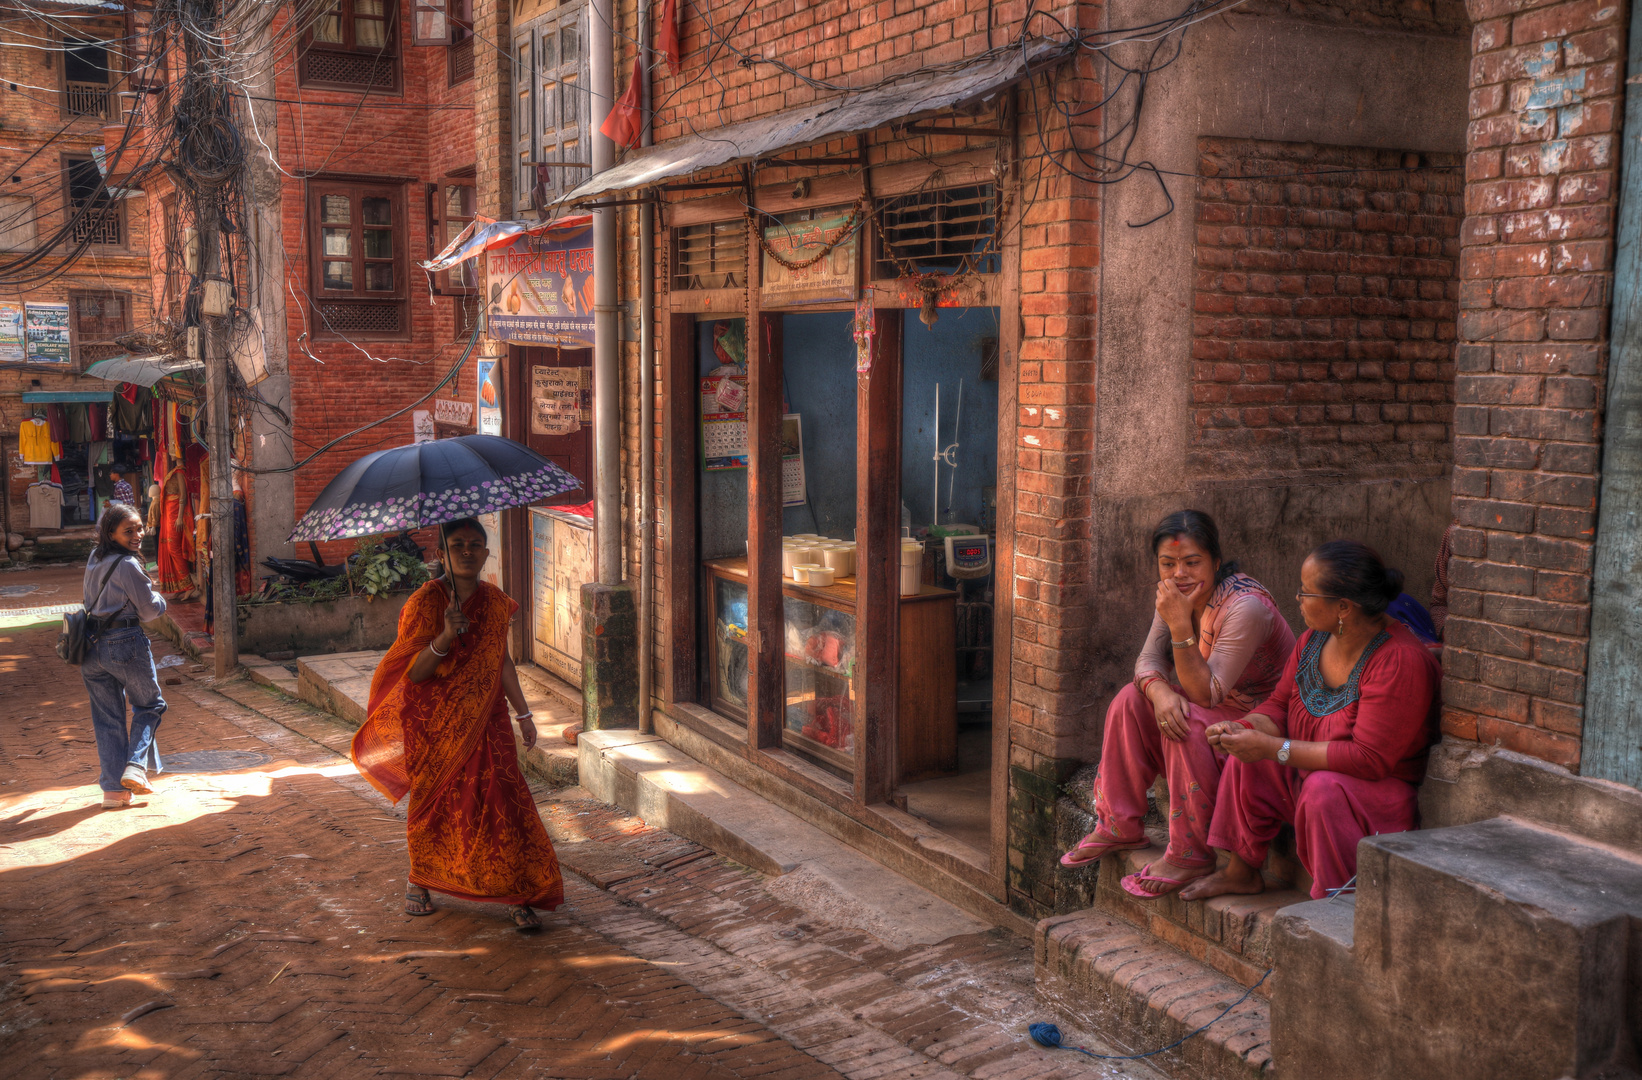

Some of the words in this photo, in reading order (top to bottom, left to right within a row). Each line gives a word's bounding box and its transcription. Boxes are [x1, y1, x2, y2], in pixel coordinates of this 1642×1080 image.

[802, 227, 822, 248] दही
[490, 254, 506, 275] जय
[544, 250, 567, 279] मासु
[564, 414, 576, 423] मासु
